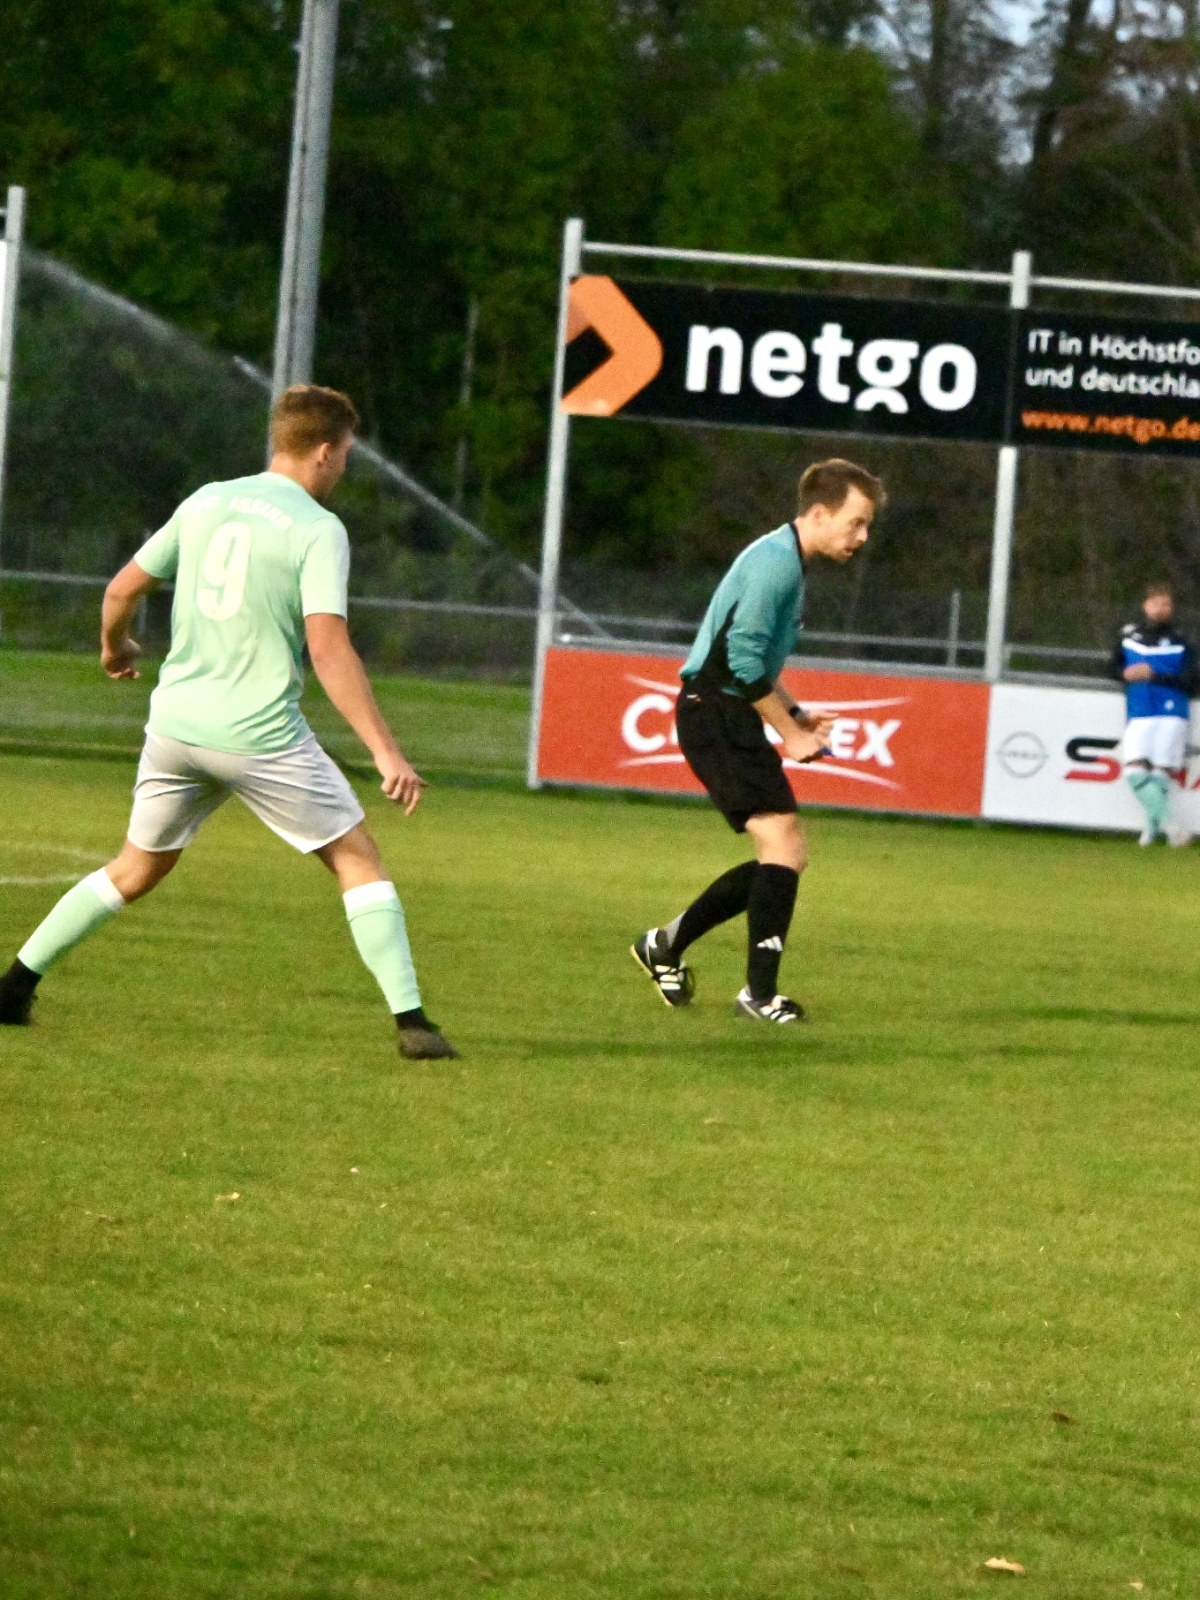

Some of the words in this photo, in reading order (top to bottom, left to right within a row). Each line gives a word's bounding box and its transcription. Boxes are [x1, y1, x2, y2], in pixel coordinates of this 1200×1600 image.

[684, 322, 977, 413] netgo
[1027, 328, 1054, 353] IT
[1059, 329, 1082, 355] in
[1025, 364, 1073, 389] und
[196, 521, 252, 622] 9
